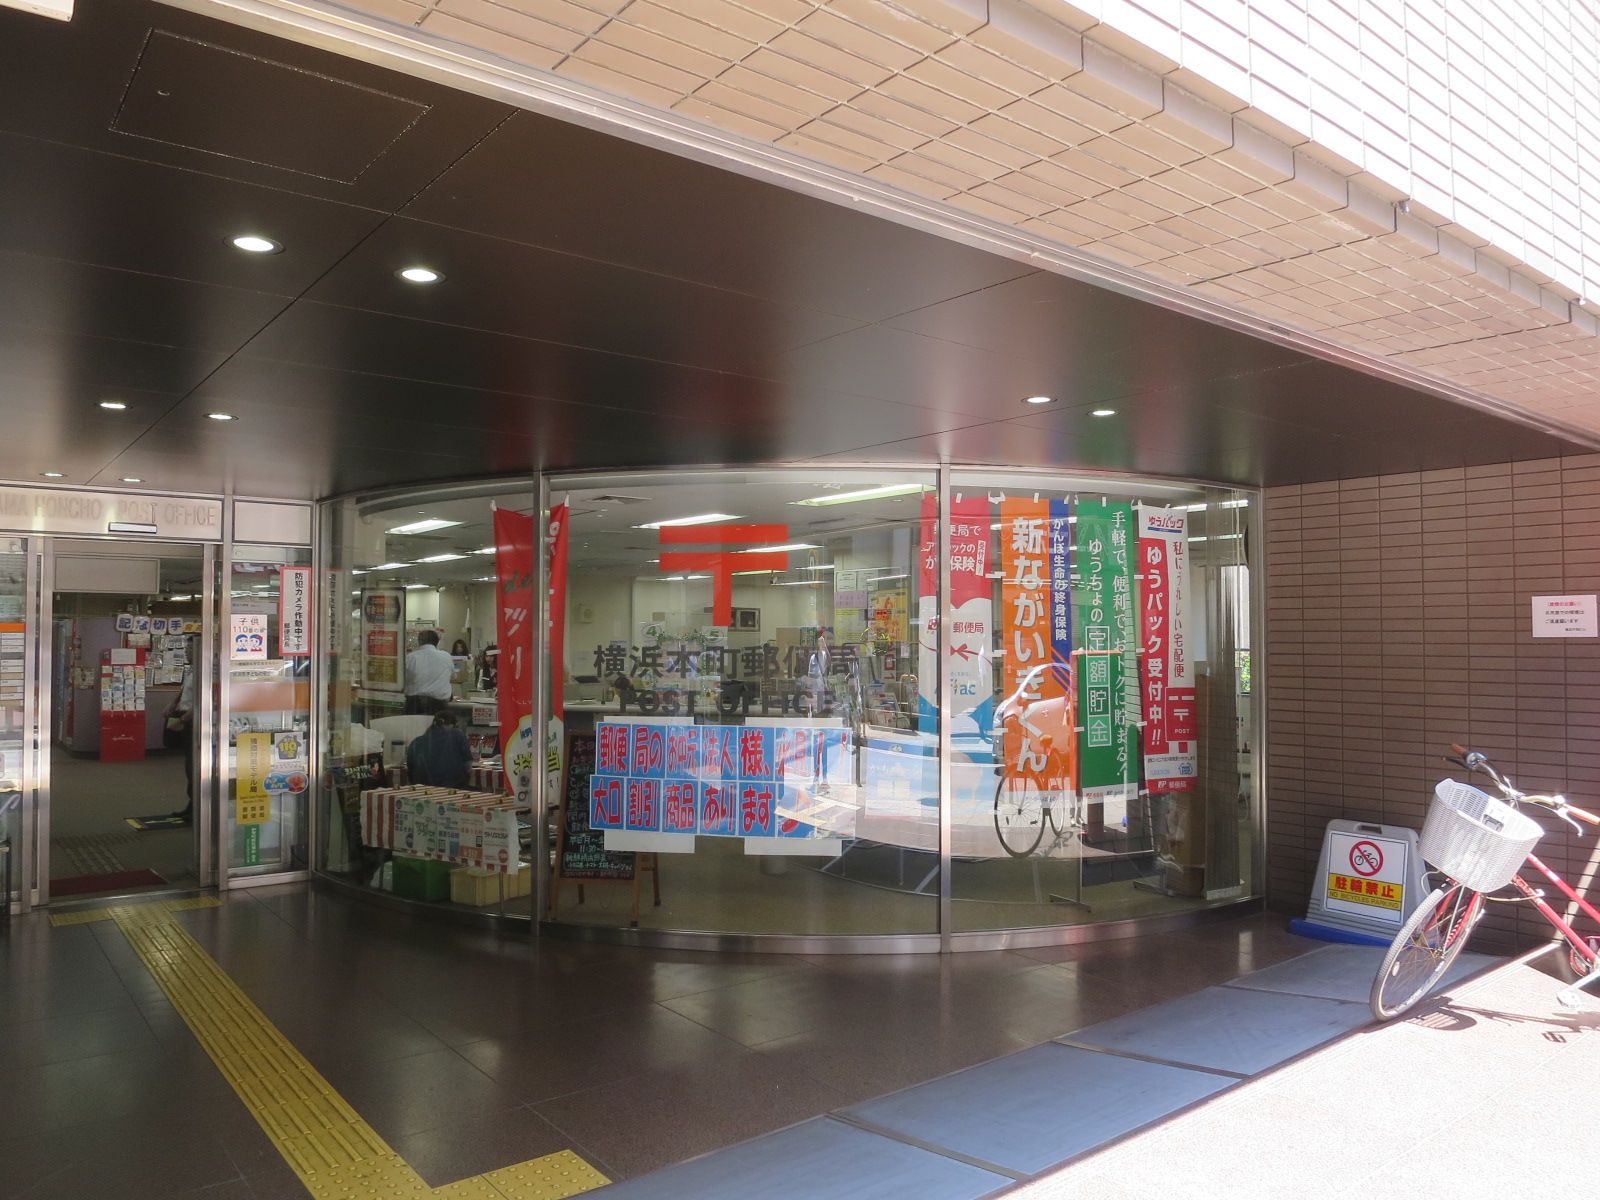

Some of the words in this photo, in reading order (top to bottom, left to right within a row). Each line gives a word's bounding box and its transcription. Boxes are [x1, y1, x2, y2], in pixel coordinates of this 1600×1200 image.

[34, 495, 103, 521] HONCHO
[117, 500, 157, 523] POST
[164, 502, 217, 526] OFFICE
[1148, 514, 1184, 529] ゆうパック
[925, 555, 976, 573] が保険
[1053, 517, 1068, 642] かんぽ生命の終身保険
[294, 572, 304, 651] 防犯カメラ作動中です
[1172, 541, 1185, 678] 私にうれしい宅配便
[952, 621, 984, 634] 郵便局
[593, 643, 856, 679] 横浜本町郵便局
[1011, 516, 1048, 773] 新ながいきくん
[1146, 546, 1164, 746] ゆうパック受付中!!
[619, 689, 697, 715] POST
[1334, 876, 1395, 899] 駐輪禁止
